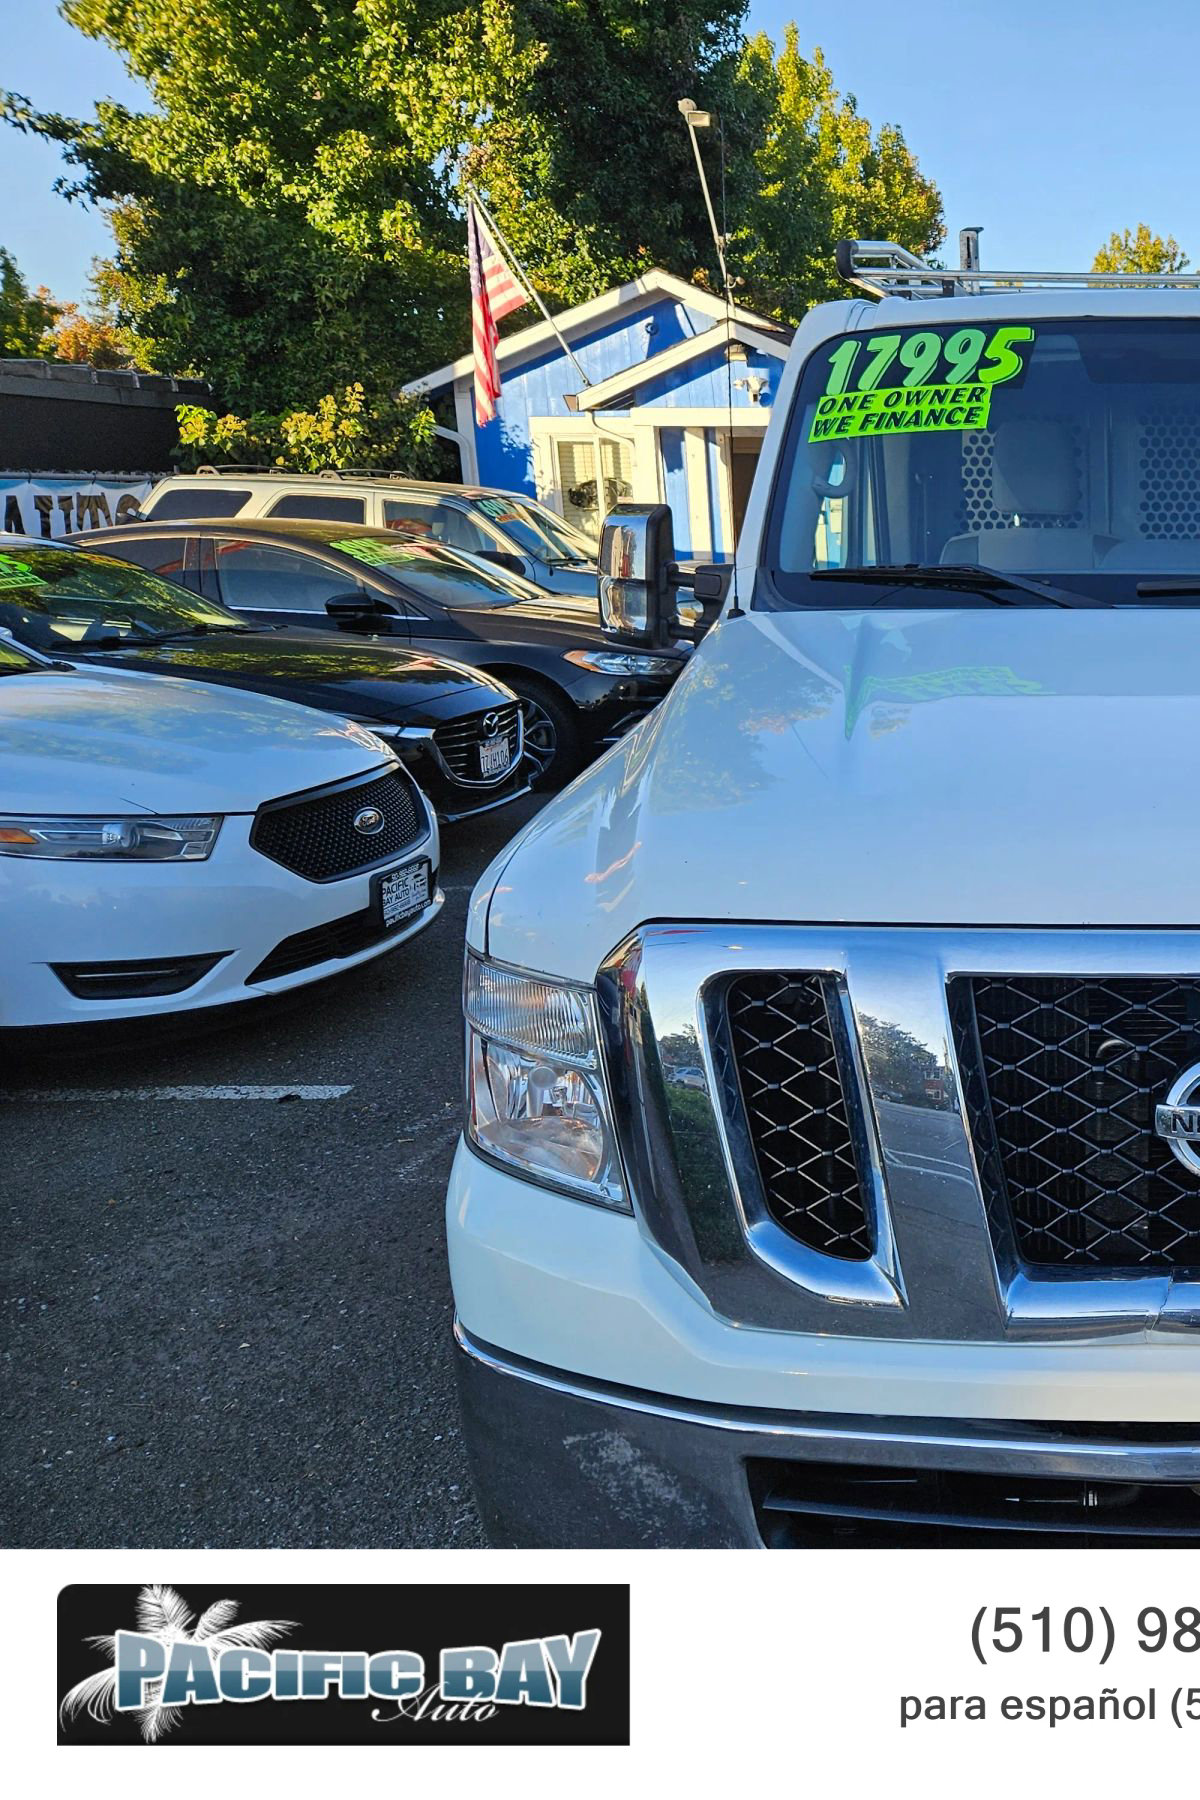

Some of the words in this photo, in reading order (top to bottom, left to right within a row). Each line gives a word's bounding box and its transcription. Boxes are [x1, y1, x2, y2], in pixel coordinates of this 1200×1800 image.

[826, 326, 1035, 396] 17995
[817, 393, 876, 416] ONE
[883, 386, 988, 409] OWNER
[813, 414, 855, 438] WE
[858, 406, 984, 432] FINANCE
[382, 877, 409, 896] PACIFIC
[394, 887, 410, 901] AUTO
